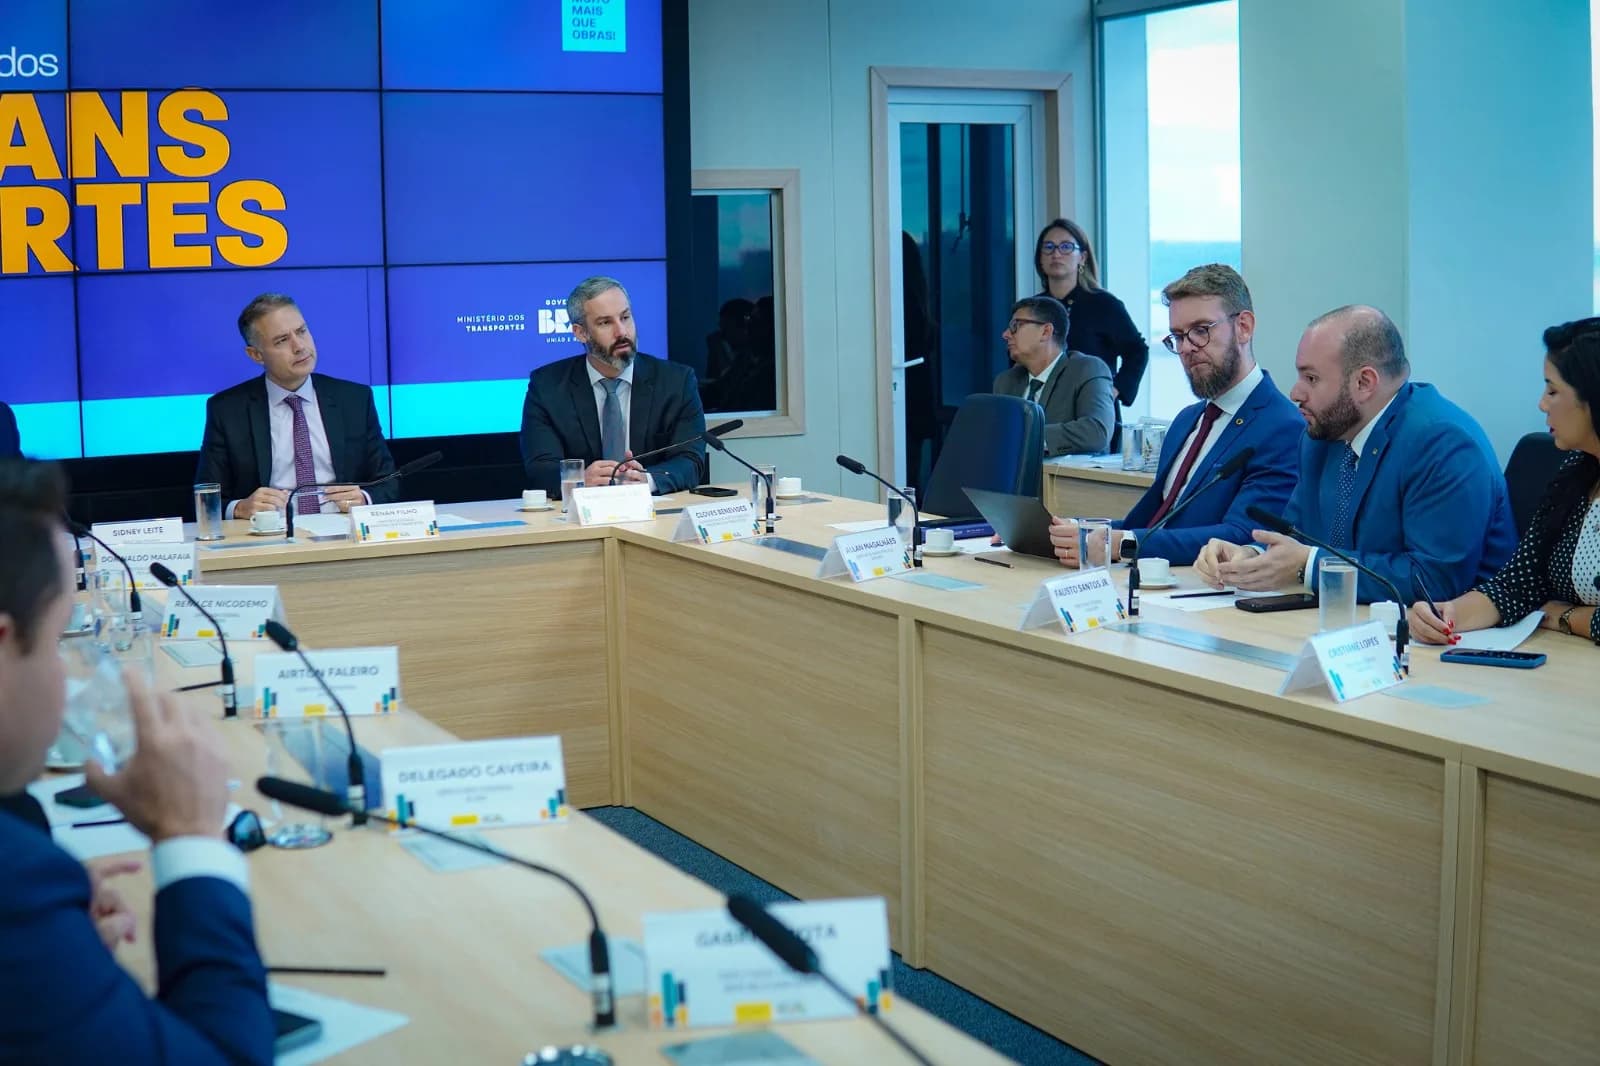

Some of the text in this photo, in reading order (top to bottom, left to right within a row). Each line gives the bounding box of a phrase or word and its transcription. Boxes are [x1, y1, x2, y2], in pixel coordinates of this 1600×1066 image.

[572, 6, 603, 16] MAIS
[572, 17, 597, 28] QUE
[0, 46, 59, 77] dos
[0, 86, 231, 180] ANS
[0, 179, 289, 274] RTES
[466, 323, 525, 332] TRANSPORTES
[113, 526, 164, 537] SIDNEY LEITE
[215, 600, 268, 608] NICODEMO
[328, 666, 379, 677] FALEIRO
[398, 760, 552, 783] DELEGADO CAVEIRA
